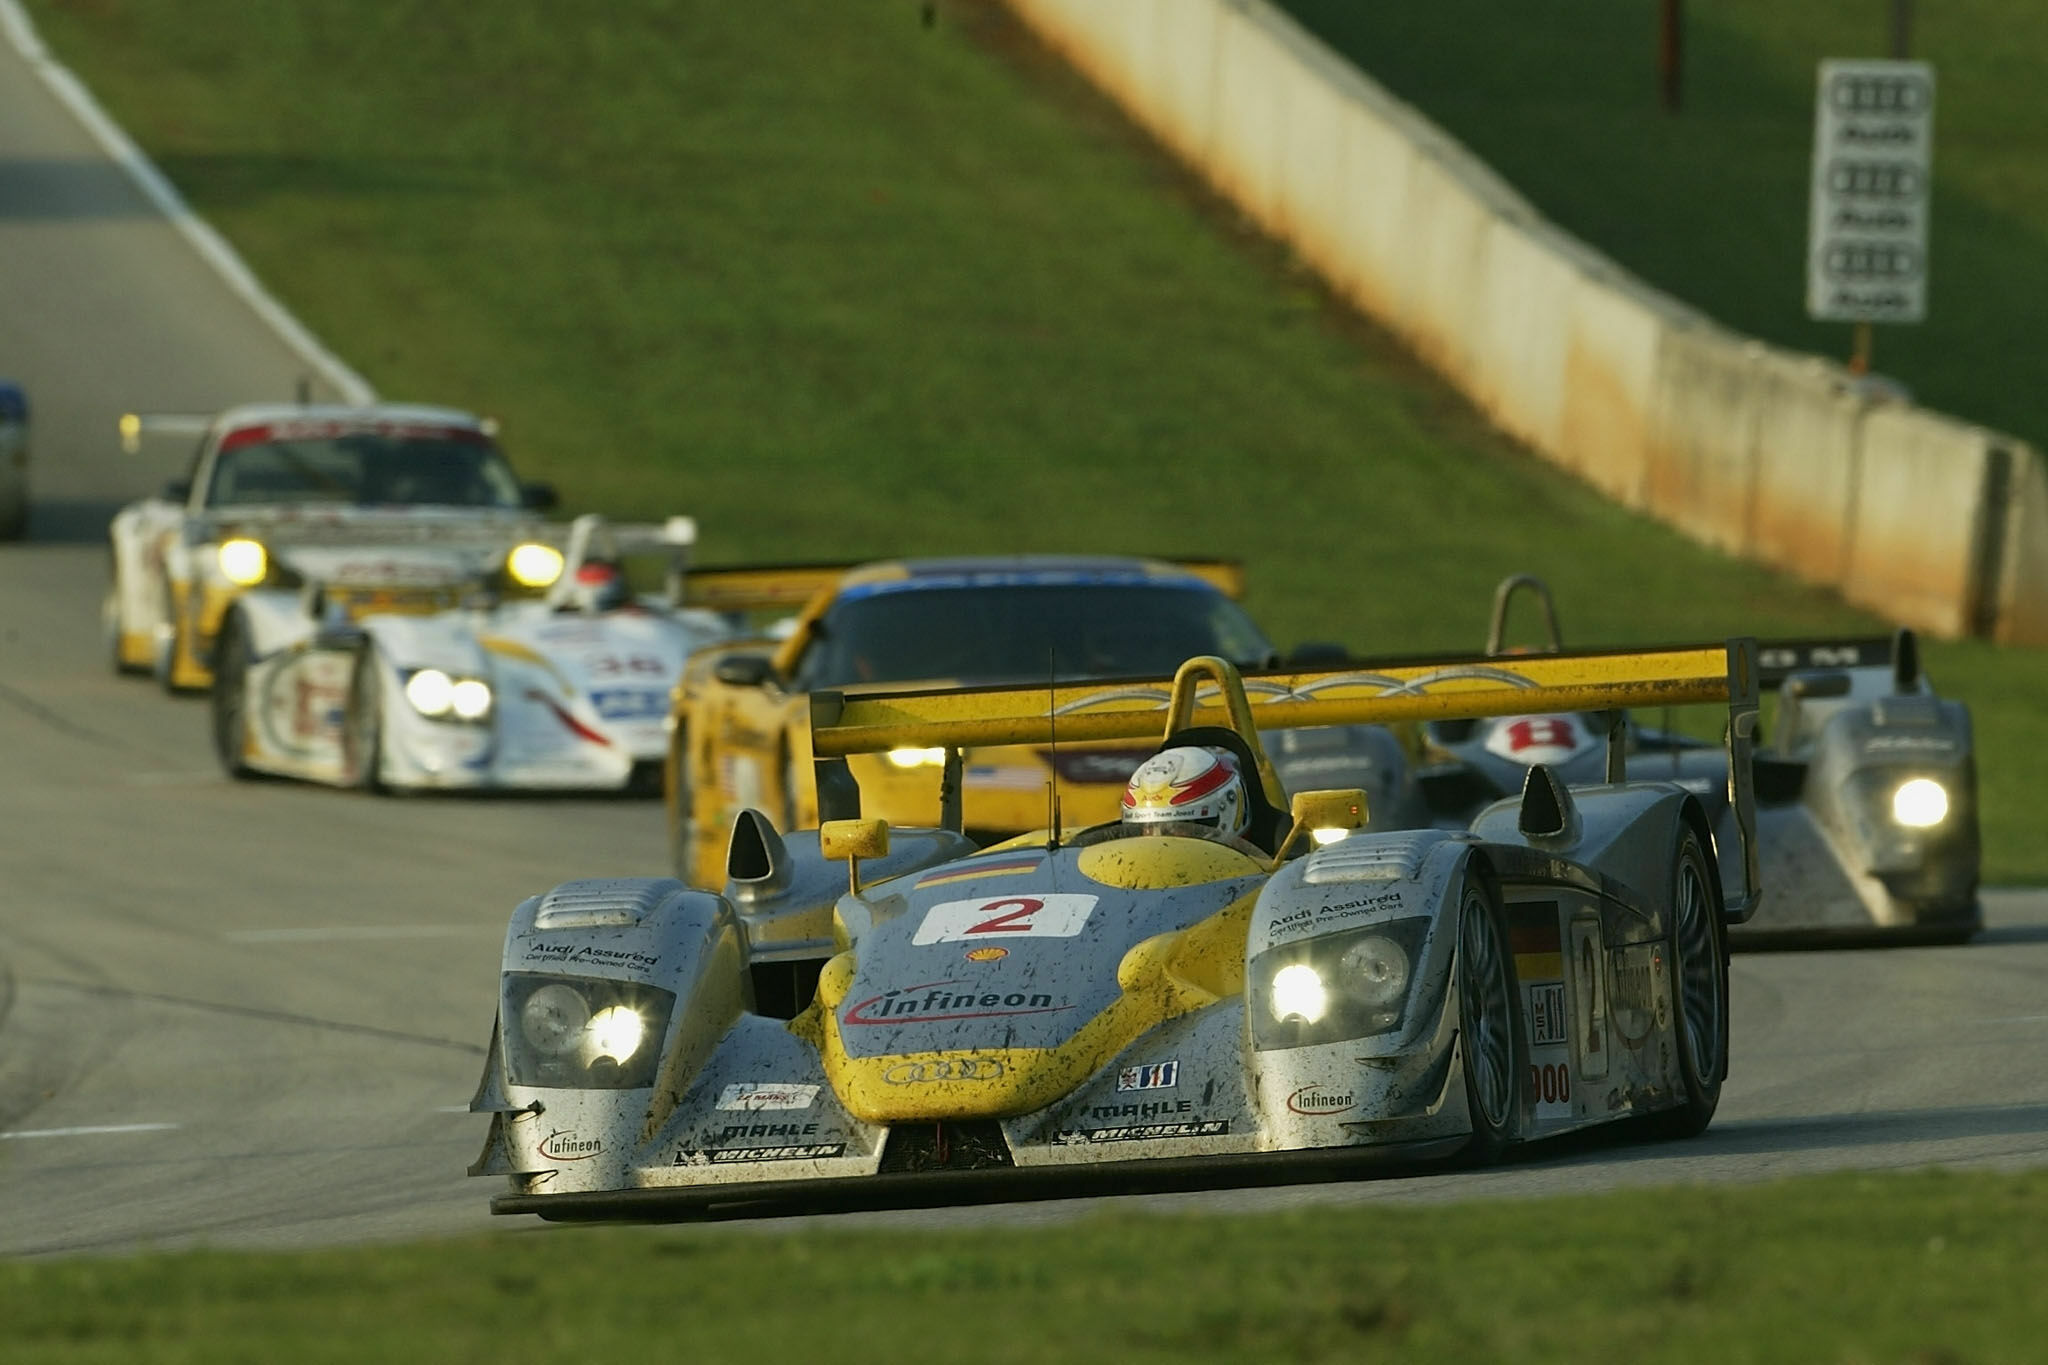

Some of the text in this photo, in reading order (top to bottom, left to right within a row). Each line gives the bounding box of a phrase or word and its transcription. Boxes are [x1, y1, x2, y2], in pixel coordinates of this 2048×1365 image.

[963, 898, 1045, 935] 2
[1268, 892, 1402, 930] Audi Assured
[1315, 906, 1377, 924] Pre-Owned
[1379, 901, 1404, 911] Cars
[531, 943, 660, 966] Audi Assured
[568, 955, 625, 968] Pre-Owned
[627, 962, 651, 973] Cars
[1093, 1100, 1192, 1119] MAHLE
[721, 1122, 820, 1139] MAHLE
[1091, 1121, 1223, 1141] MICHELIN
[713, 1144, 842, 1162] MICHELIN
